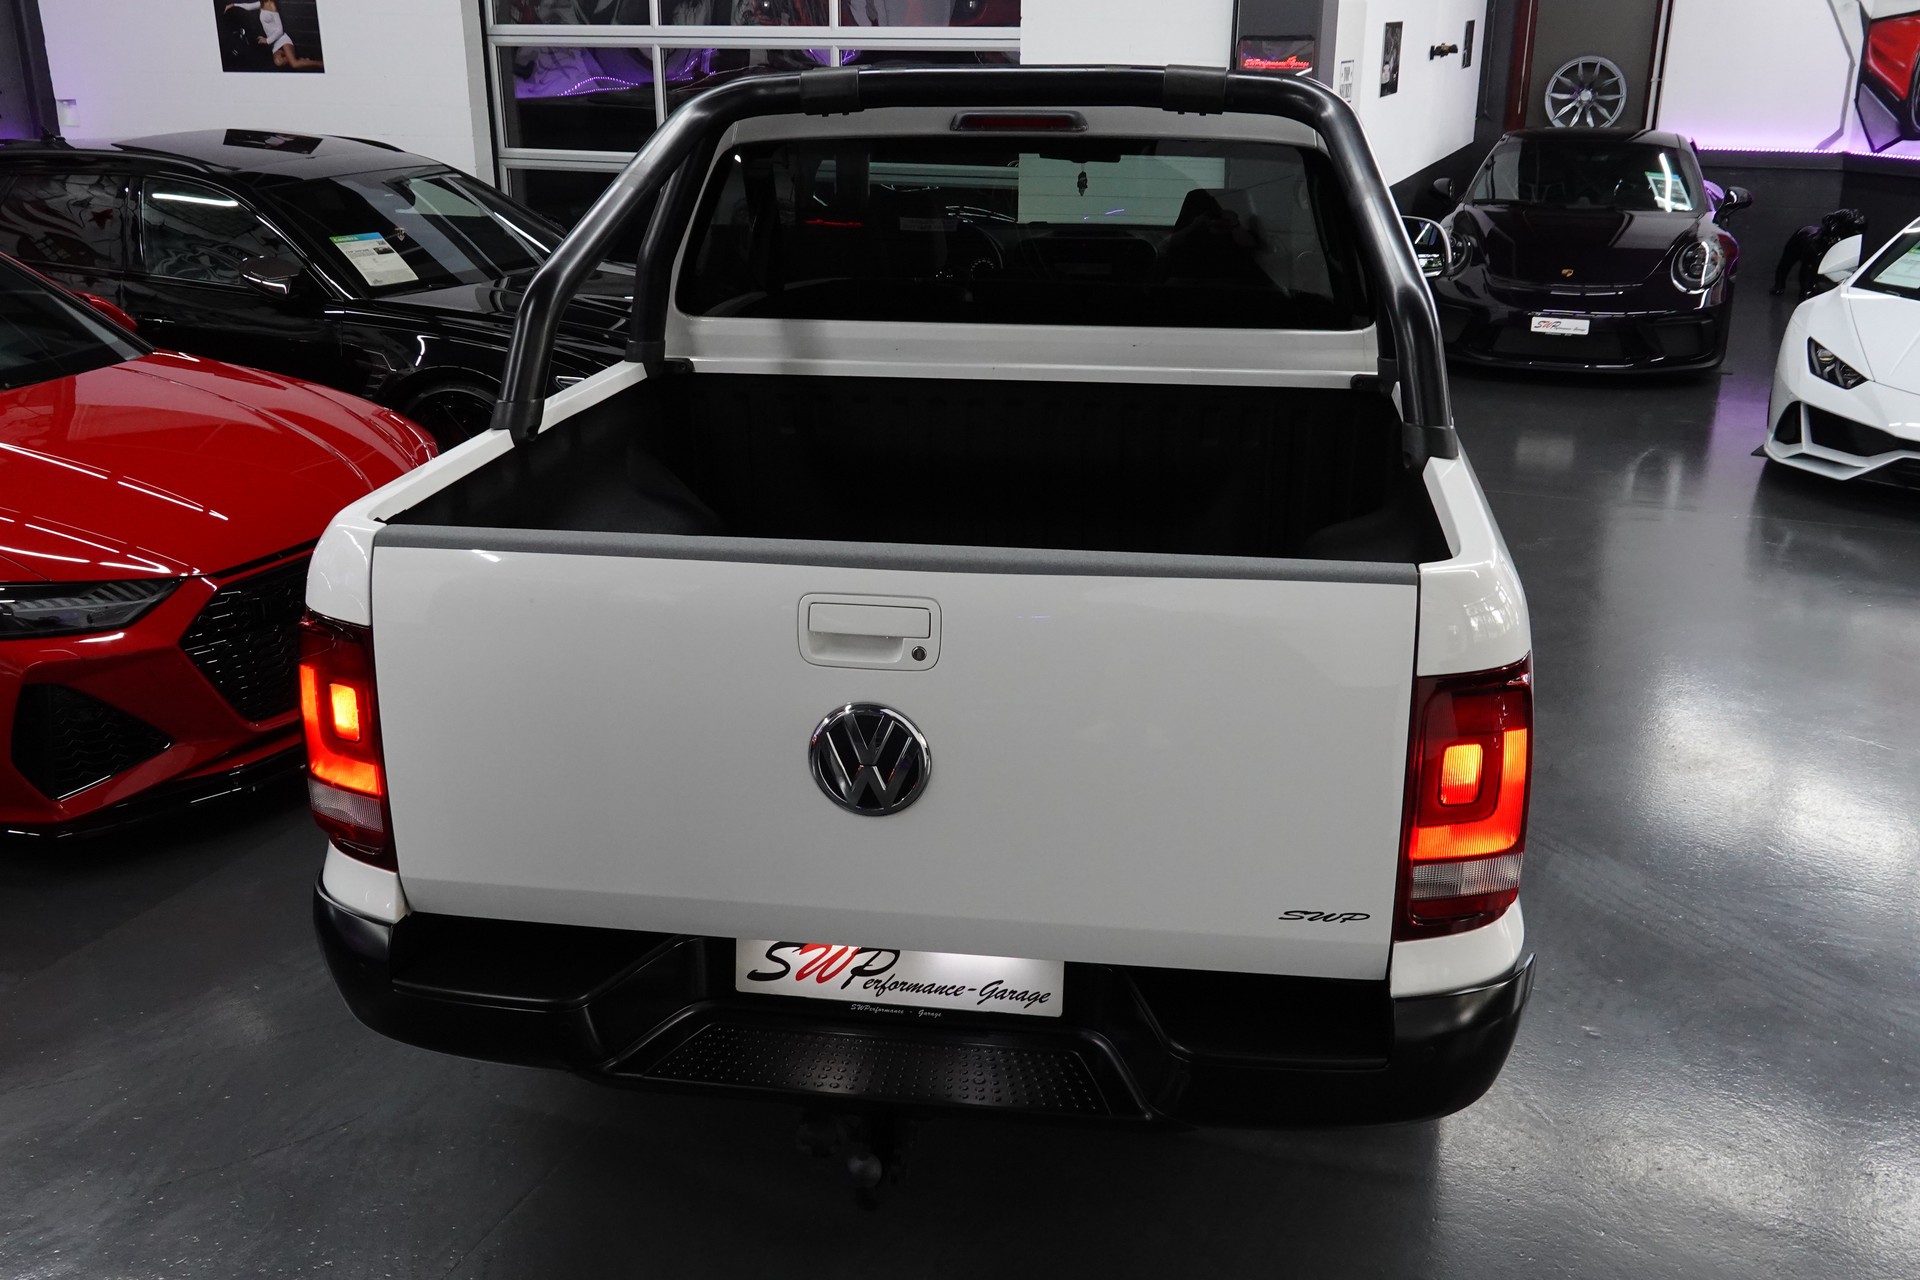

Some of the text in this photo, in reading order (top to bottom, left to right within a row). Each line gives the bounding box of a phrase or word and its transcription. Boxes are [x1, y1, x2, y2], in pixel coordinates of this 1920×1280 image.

[1278, 910, 1370, 923] SWP
[850, 1003, 904, 1014] SWPerformance
[917, 1009, 942, 1018] Garage
